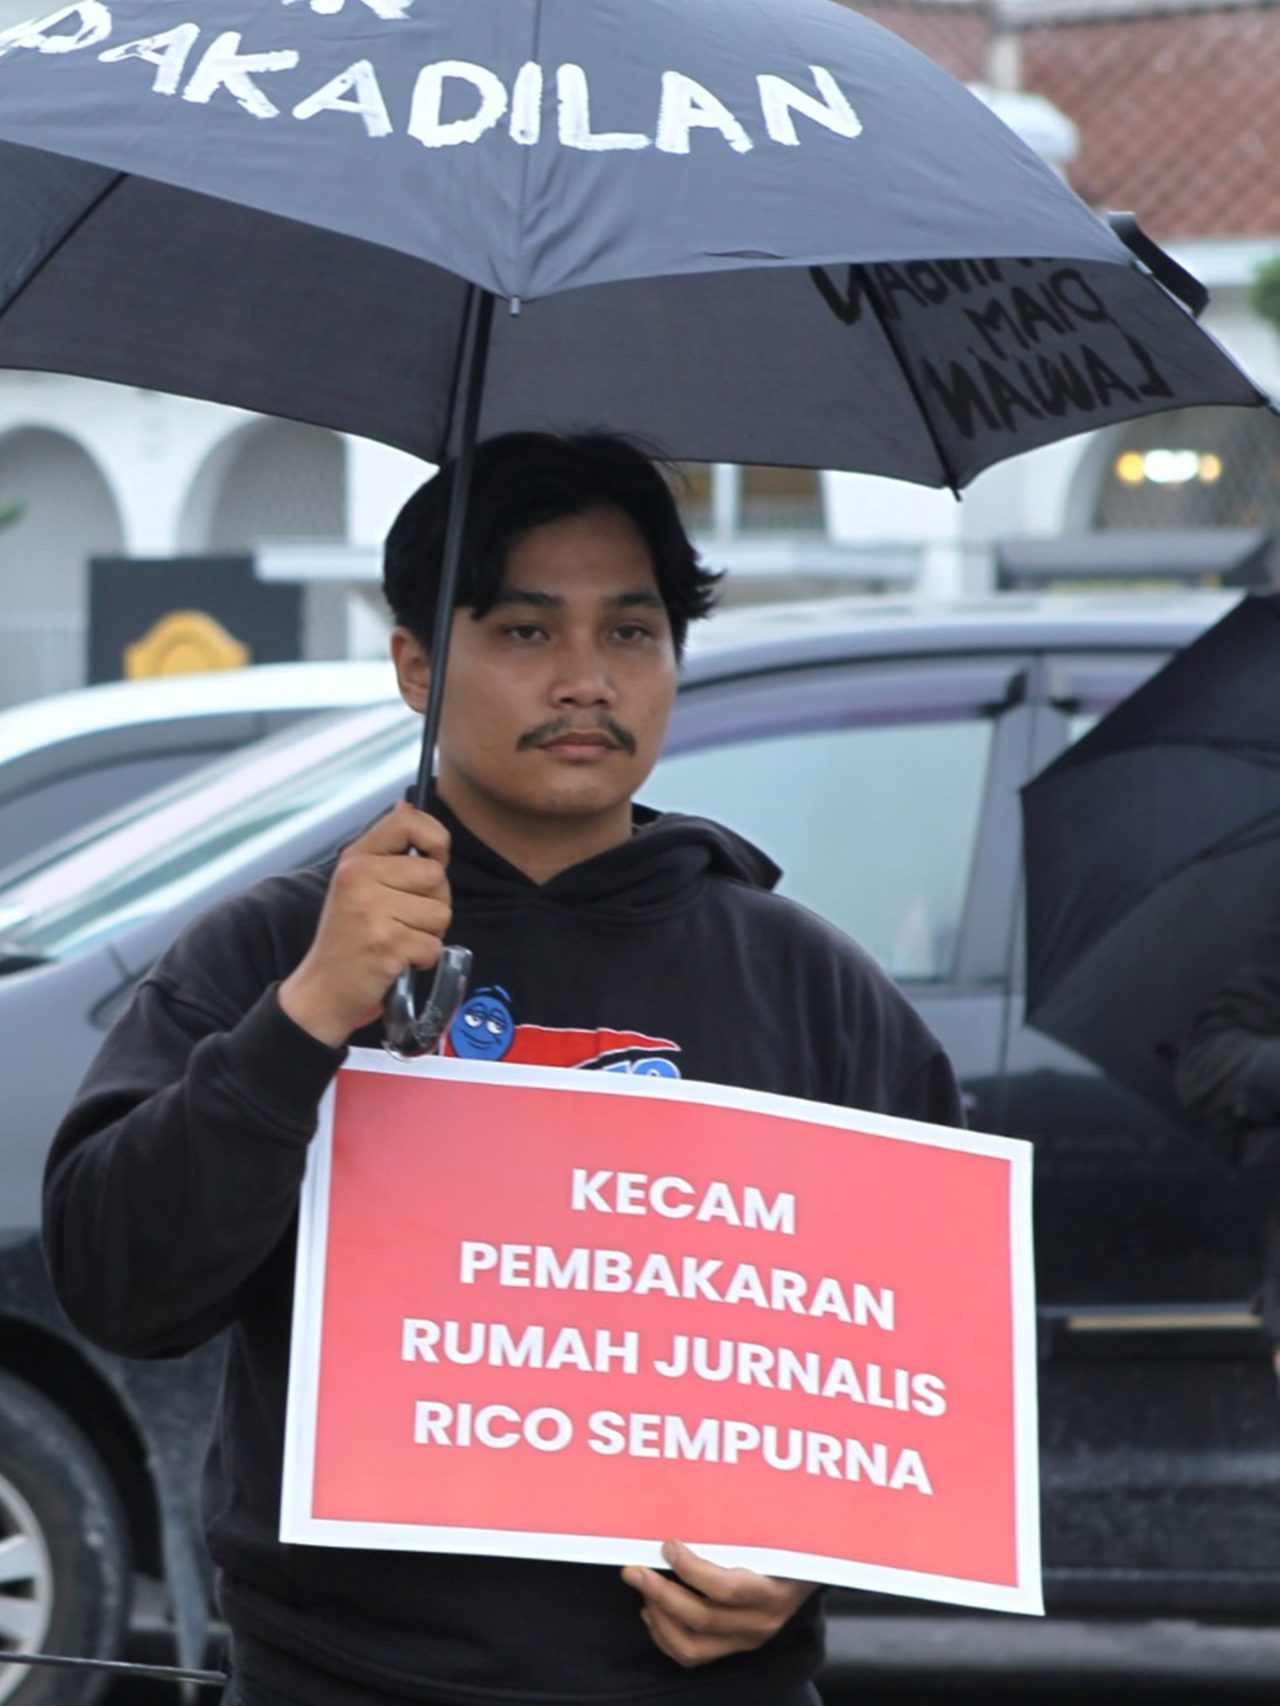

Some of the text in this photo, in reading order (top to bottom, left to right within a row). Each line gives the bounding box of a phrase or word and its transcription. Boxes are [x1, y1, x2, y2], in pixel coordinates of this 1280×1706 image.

[572, 1168, 795, 1235] KECAM
[460, 1241, 894, 1331] PEMBAKARAN
[401, 1318, 947, 1417] RUMAH JURNALIS
[414, 1400, 933, 1495] RICO SEMPURNA
